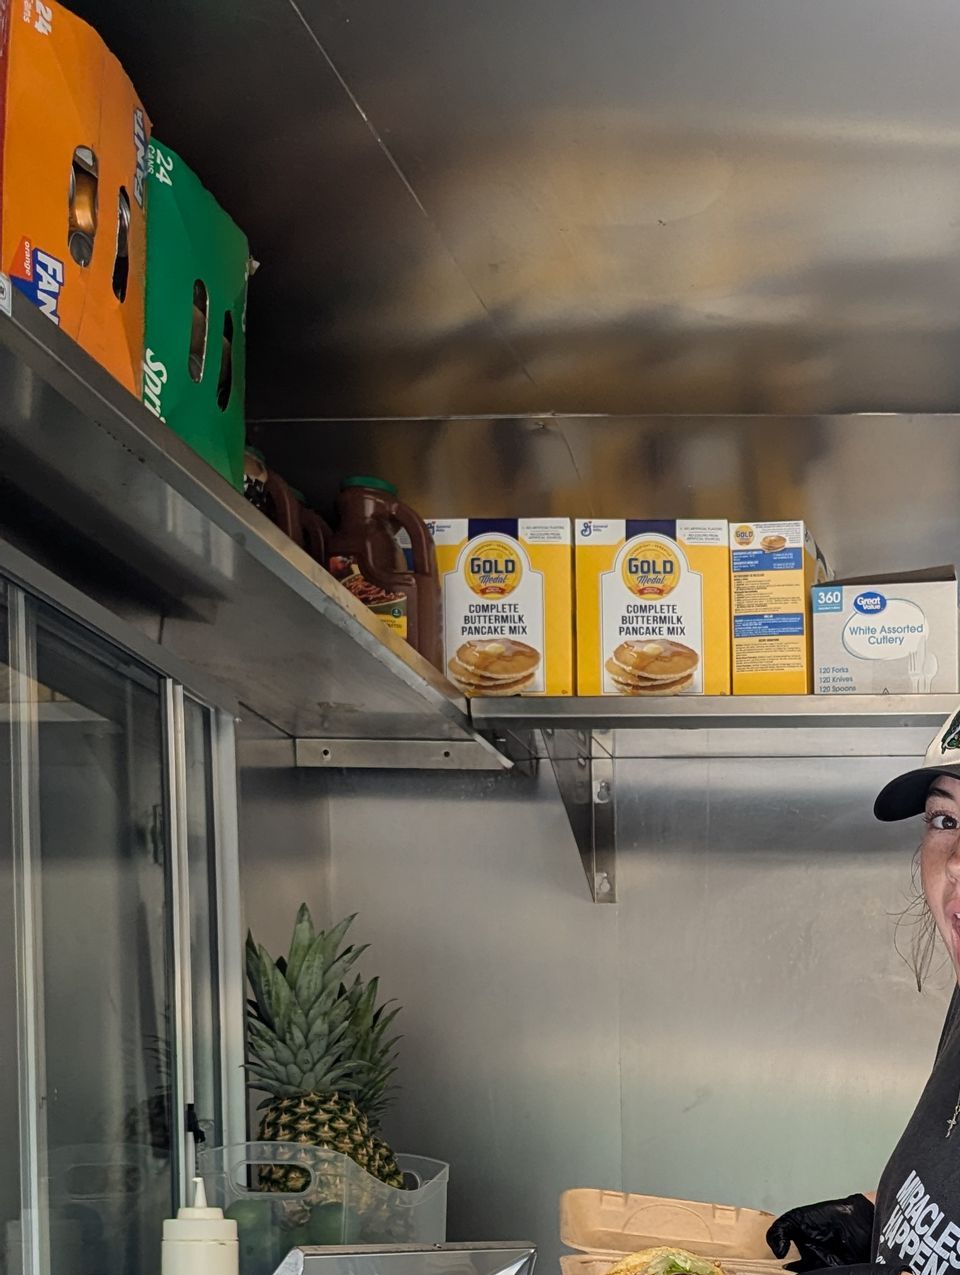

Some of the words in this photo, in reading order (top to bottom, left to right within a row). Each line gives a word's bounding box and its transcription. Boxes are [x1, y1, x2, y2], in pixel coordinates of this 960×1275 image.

[156, 149, 173, 186] 24
[23, 241, 31, 276] orange
[470, 557, 516, 574] GOLD
[628, 558, 674, 575] GOLD
[479, 575, 508, 585] Medal
[636, 576, 666, 586] Medal
[818, 591, 841, 604] 360
[856, 596, 881, 606] Great
[468, 604, 519, 614] COMPLETE
[626, 605, 676, 615] COMPLETE
[464, 614, 525, 625] BUTTERMILK
[622, 616, 682, 626] BUTTERMILK
[461, 626, 506, 636] PANCAKE
[508, 625, 528, 636] MIX
[618, 626, 664, 637] PANCAKE
[666, 626, 686, 636] MIX
[850, 626, 877, 636] White
[880, 623, 924, 634] Assorted
[867, 635, 905, 646] Cutlery
[819, 667, 831, 675] 120
[832, 666, 849, 674] Forks
[832, 675, 853, 683] Knives
[832, 685, 856, 693] Spoons
